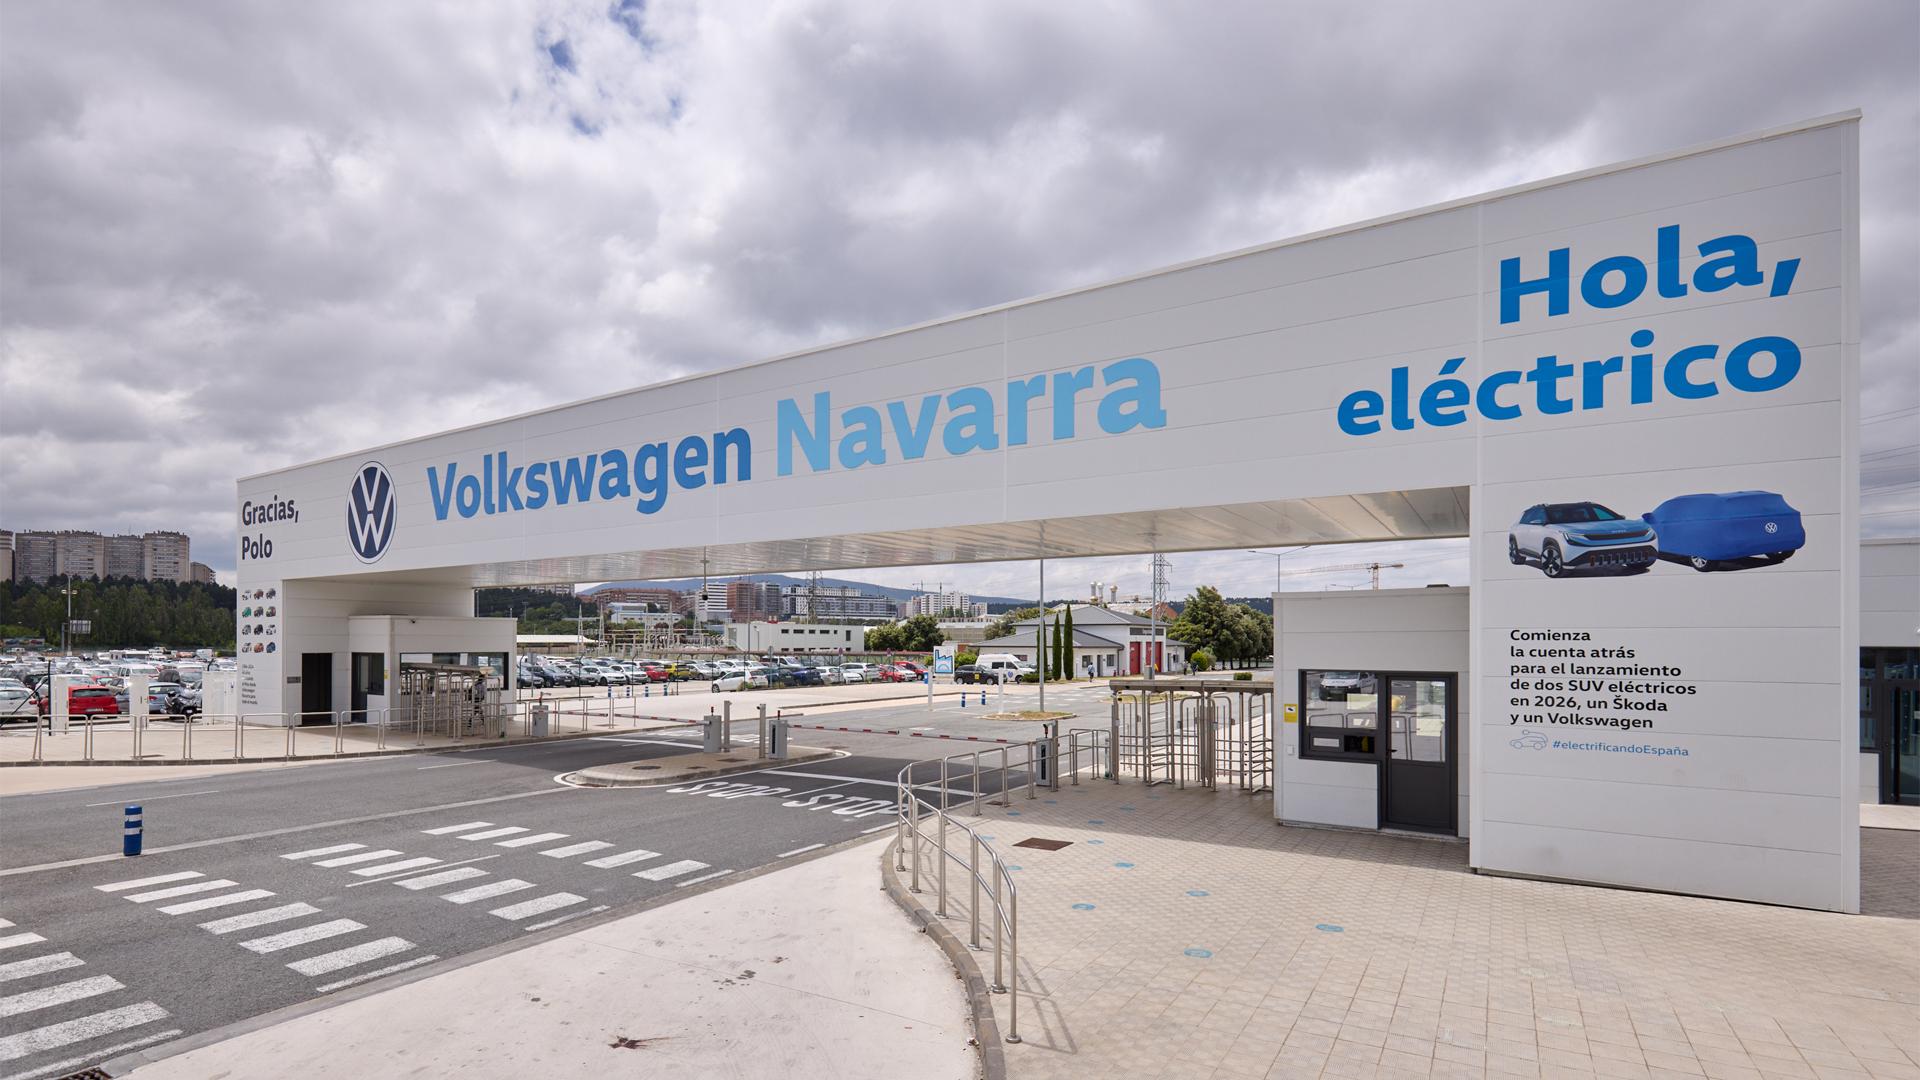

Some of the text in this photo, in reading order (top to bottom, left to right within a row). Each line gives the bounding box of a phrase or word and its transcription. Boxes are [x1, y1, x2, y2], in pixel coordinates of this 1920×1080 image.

[1500, 224, 1801, 324] Hola,
[1337, 329, 1801, 436] eléctrico
[427, 357, 1167, 515] Volkswagen Navarra
[241, 495, 299, 526] Gracias,
[241, 533, 273, 560] Polo
[1510, 629, 1591, 641] Comienza
[1510, 646, 1635, 658] la cuenta atrás
[1510, 663, 1682, 677] para el lanzamiento
[1510, 679, 1697, 695] de dos SUV eléctricos
[1510, 695, 1668, 711] en 2026, un Škoda
[1510, 713, 1654, 729] y un Volkswagen
[1552, 740, 1689, 756] #electrificandoEspaña
[666, 781, 792, 799] STOP
